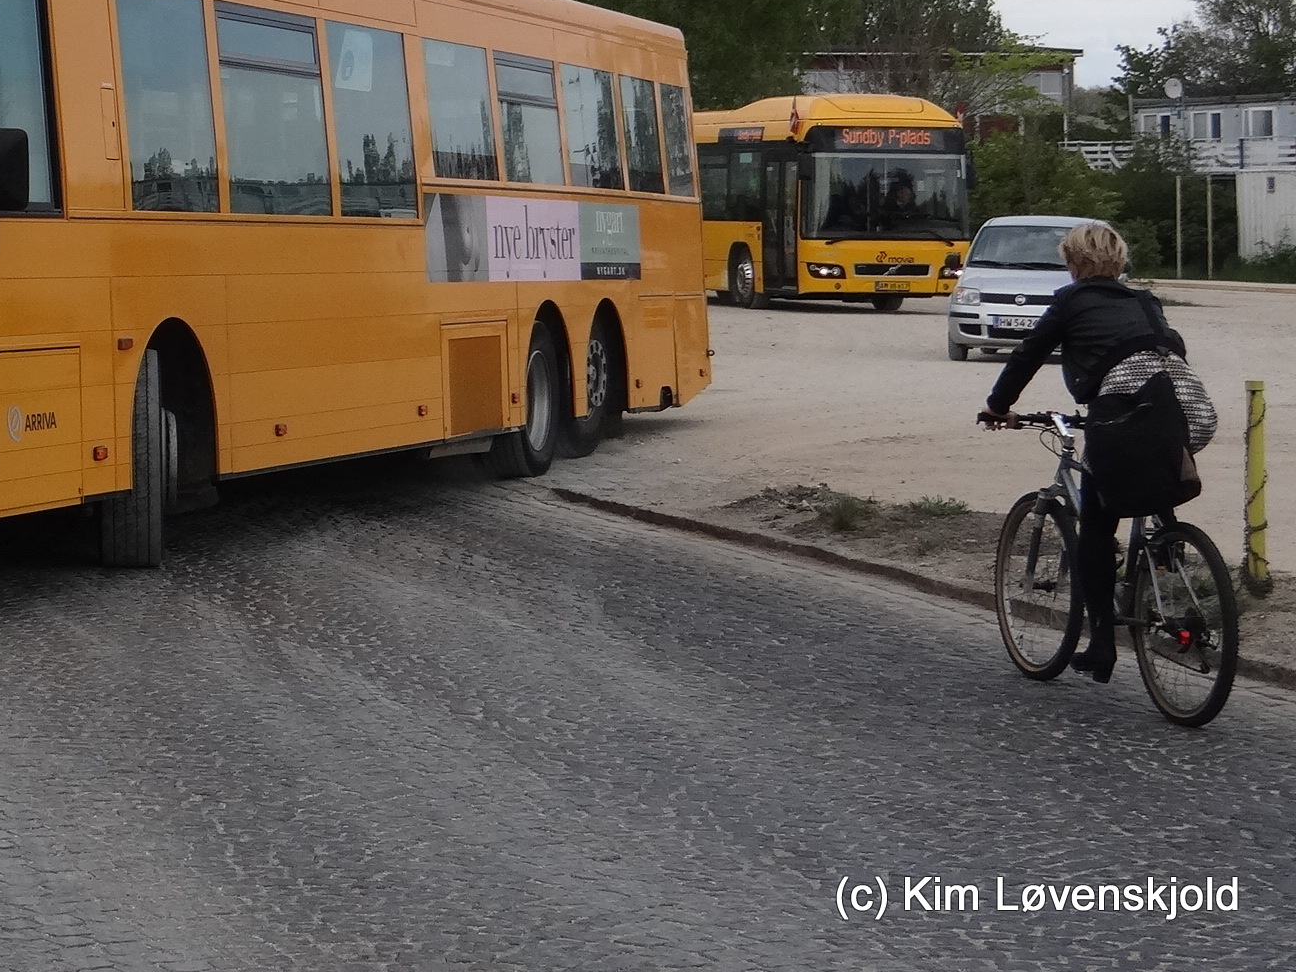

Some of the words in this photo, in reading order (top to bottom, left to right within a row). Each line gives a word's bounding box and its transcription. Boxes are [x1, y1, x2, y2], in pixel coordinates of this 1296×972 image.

[842, 128, 884, 148] Sundby
[888, 129, 931, 148] P-plads
[493, 224, 521, 264] nye
[523, 204, 576, 264] bryster
[1014, 319, 1025, 327] 54
[24, 412, 57, 433] ARRIVA
